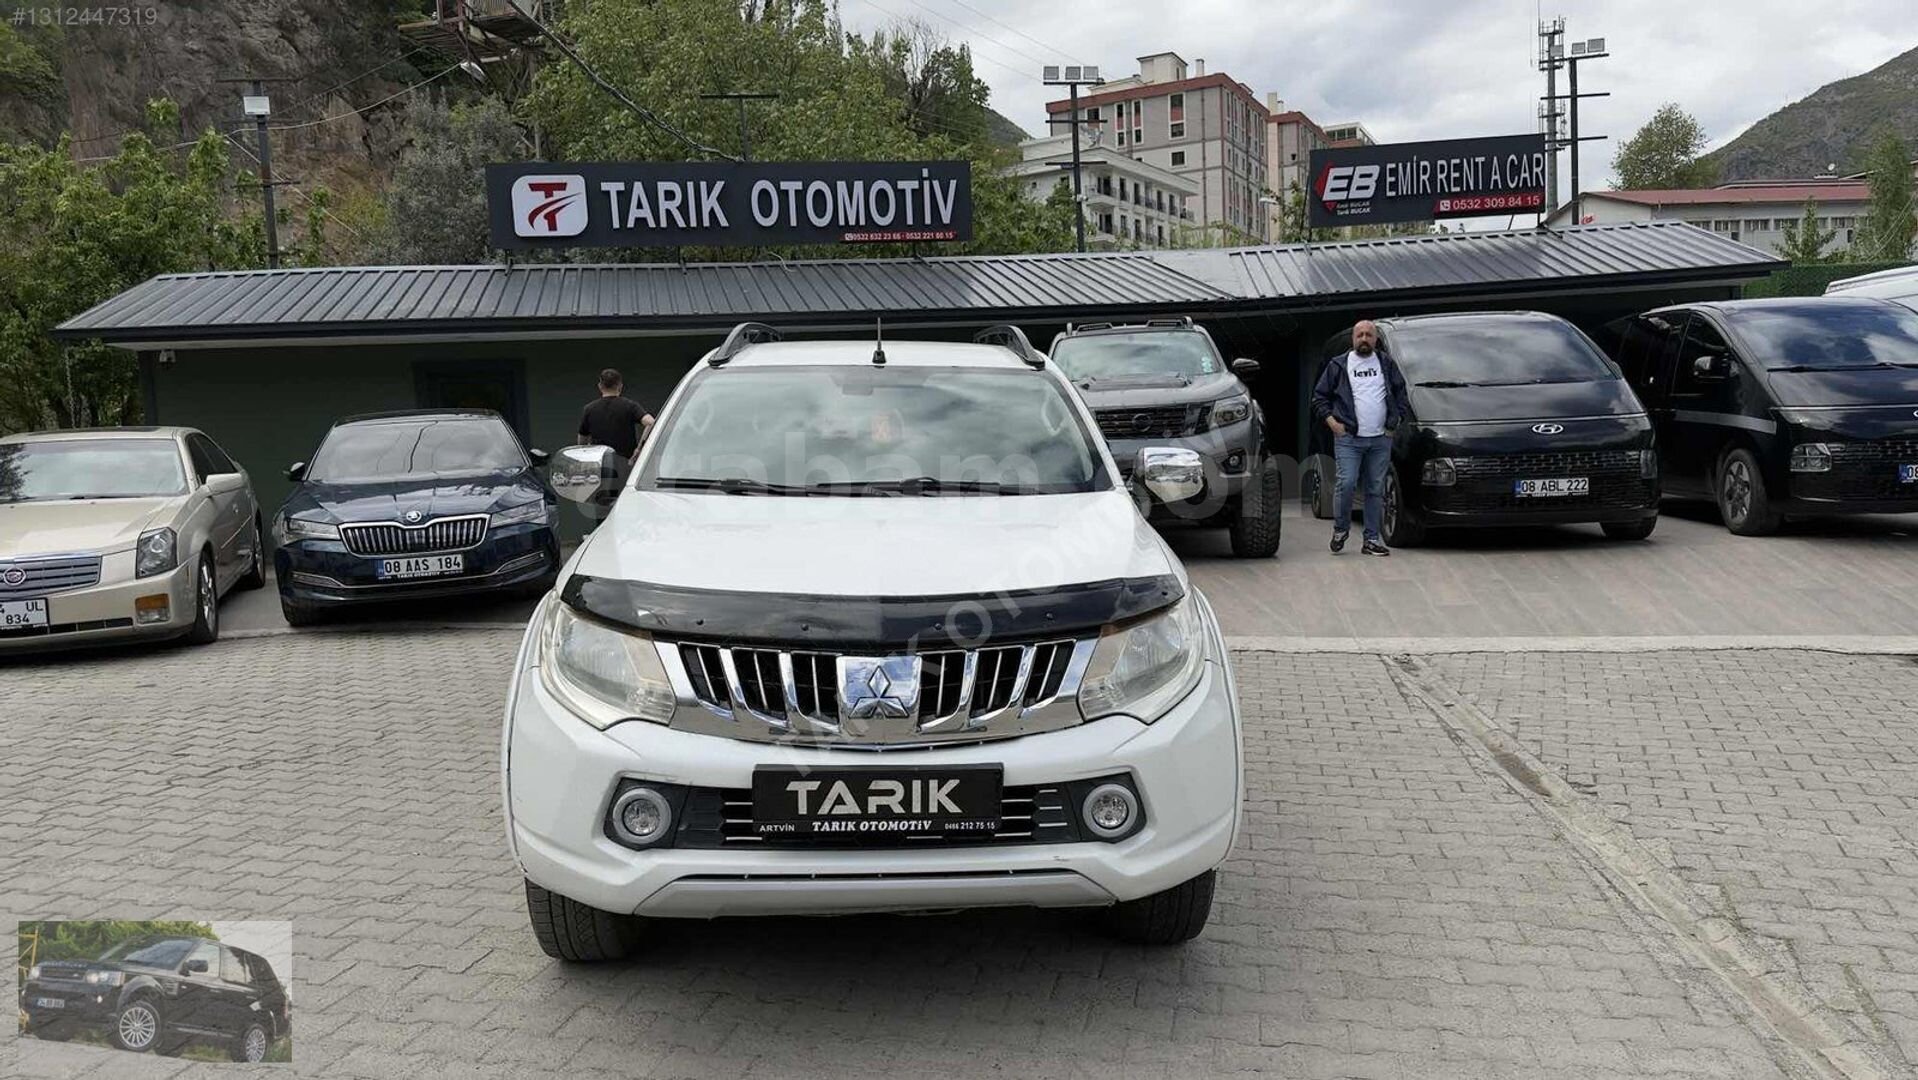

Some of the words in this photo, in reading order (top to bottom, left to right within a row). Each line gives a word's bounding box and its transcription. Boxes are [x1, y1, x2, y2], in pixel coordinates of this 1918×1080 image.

[1322, 165, 1380, 201] EB
[1386, 155, 1431, 197] EMİR
[1437, 157, 1486, 193] RENT
[1490, 156, 1502, 190] A
[1506, 153, 1544, 189] CAR
[600, 180, 730, 230] TARIK
[750, 168, 957, 228] OTOMOTİV
[1453, 199, 1481, 210] 0532
[1484, 198, 1507, 209] 309
[1509, 197, 1522, 207] 84
[1526, 196, 1541, 206] 15
[1521, 481, 1536, 493] 08
[1540, 480, 1565, 492] ABL
[1566, 479, 1588, 491] 222
[384, 561, 401, 574] 08
[406, 559, 430, 572] AAS
[437, 556, 461, 570] 184
[26, 601, 44, 612] UL
[6, 613, 30, 625] 834
[786, 779, 964, 815] TARIK
[812, 820, 856, 832] TARIK
